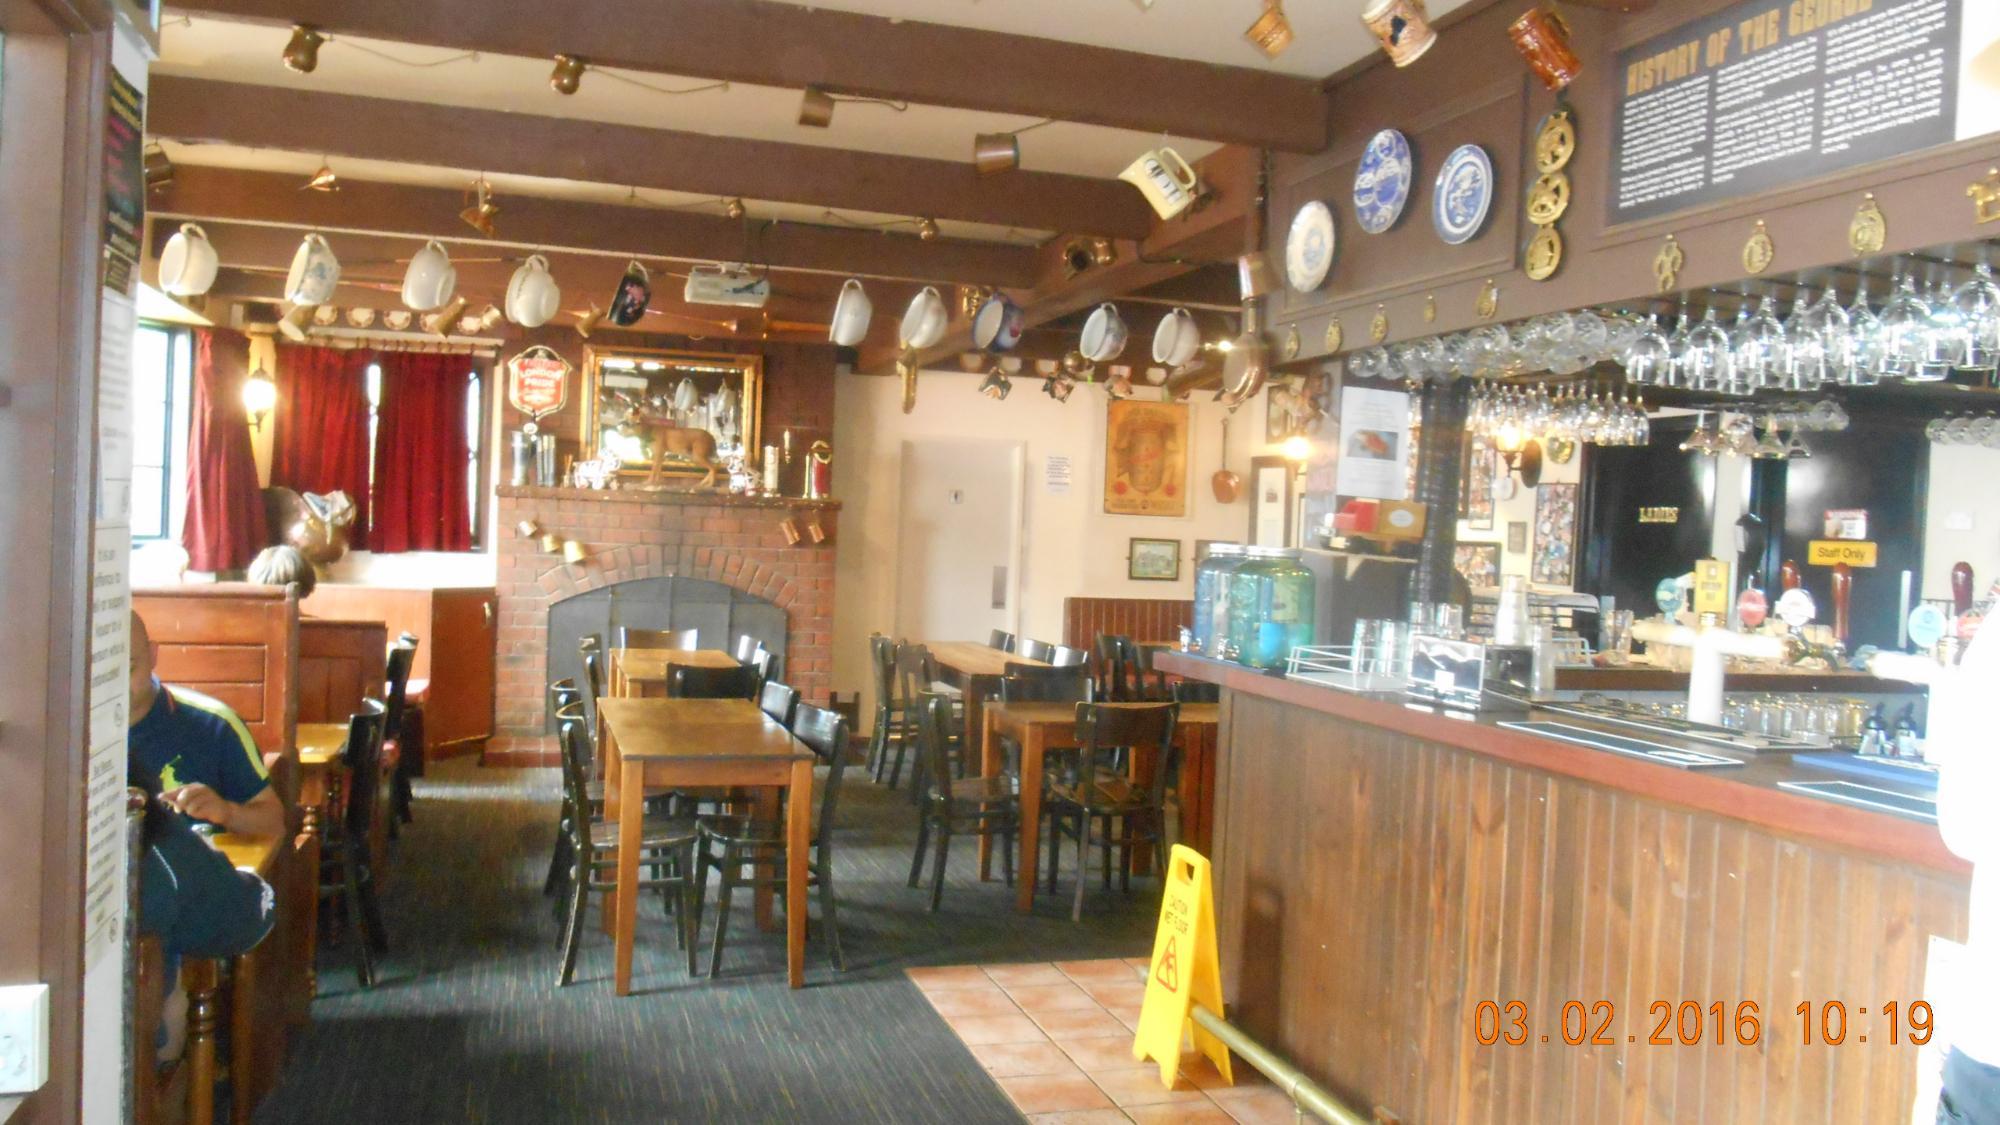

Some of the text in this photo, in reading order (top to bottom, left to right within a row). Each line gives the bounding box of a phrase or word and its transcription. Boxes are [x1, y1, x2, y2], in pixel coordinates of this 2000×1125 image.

[1627, 40, 1699, 96] HISTORY
[1706, 27, 1731, 67] OF
[1739, 9, 1779, 54] THE
[1818, 547, 1865, 561] Staff Only
